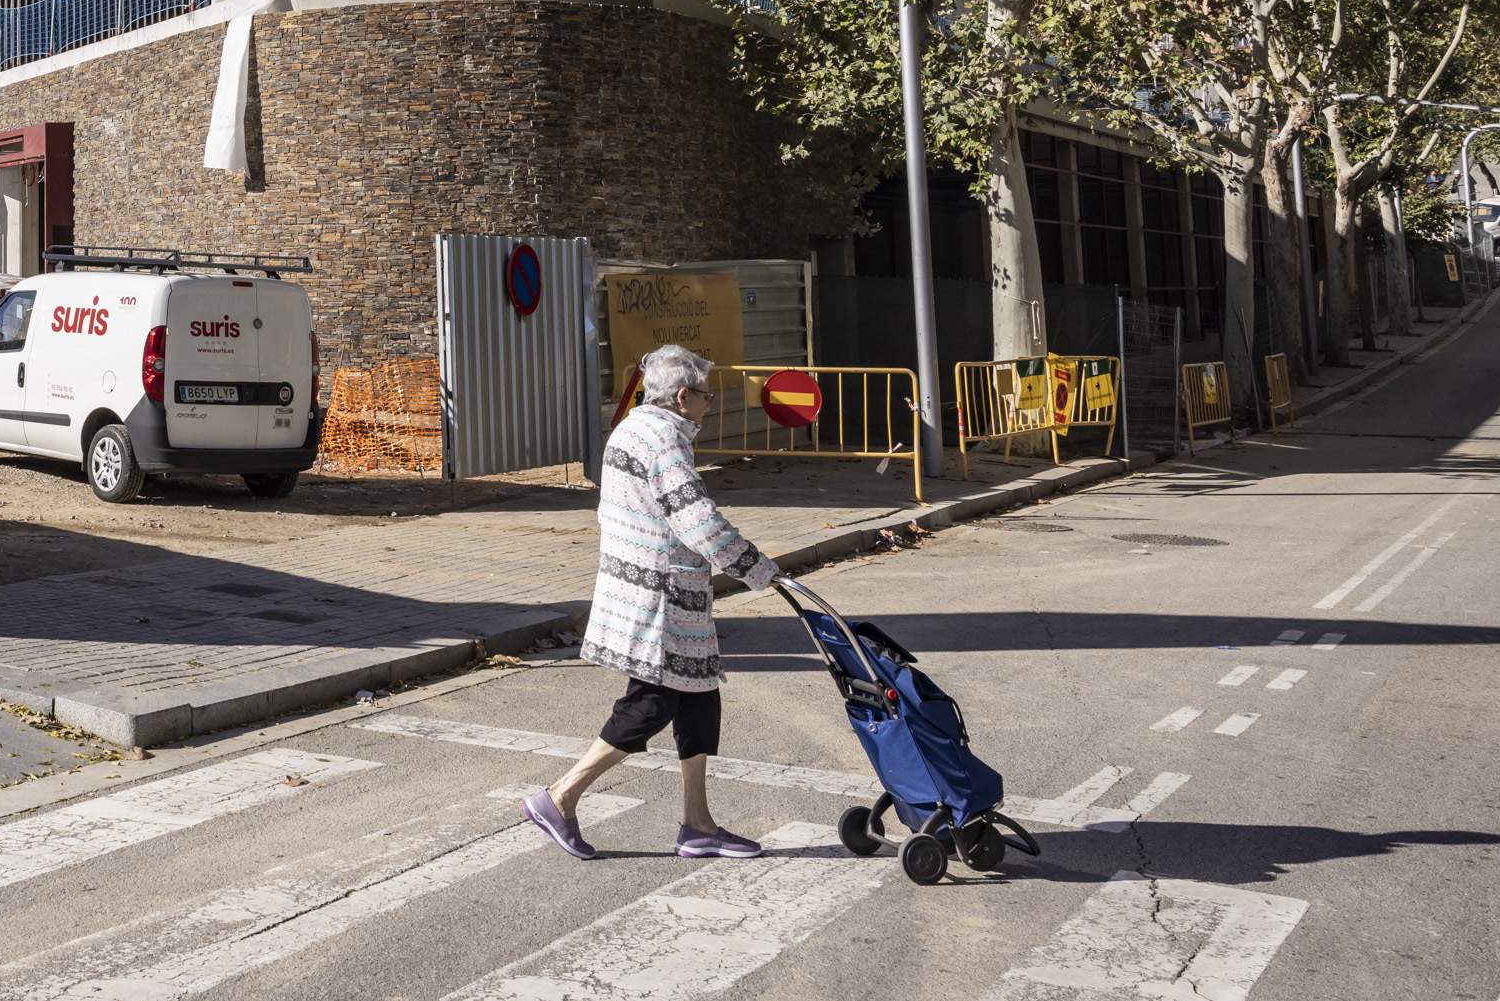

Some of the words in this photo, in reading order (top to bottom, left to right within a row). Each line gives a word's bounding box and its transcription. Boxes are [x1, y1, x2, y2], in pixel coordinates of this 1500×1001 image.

[51, 295, 109, 336] suris
[190, 314, 240, 338] suris
[653, 327, 671, 344] NOU
[673, 325, 701, 343] MERCAT
[187, 387, 214, 399] 8650
[217, 388, 236, 399] LYP
